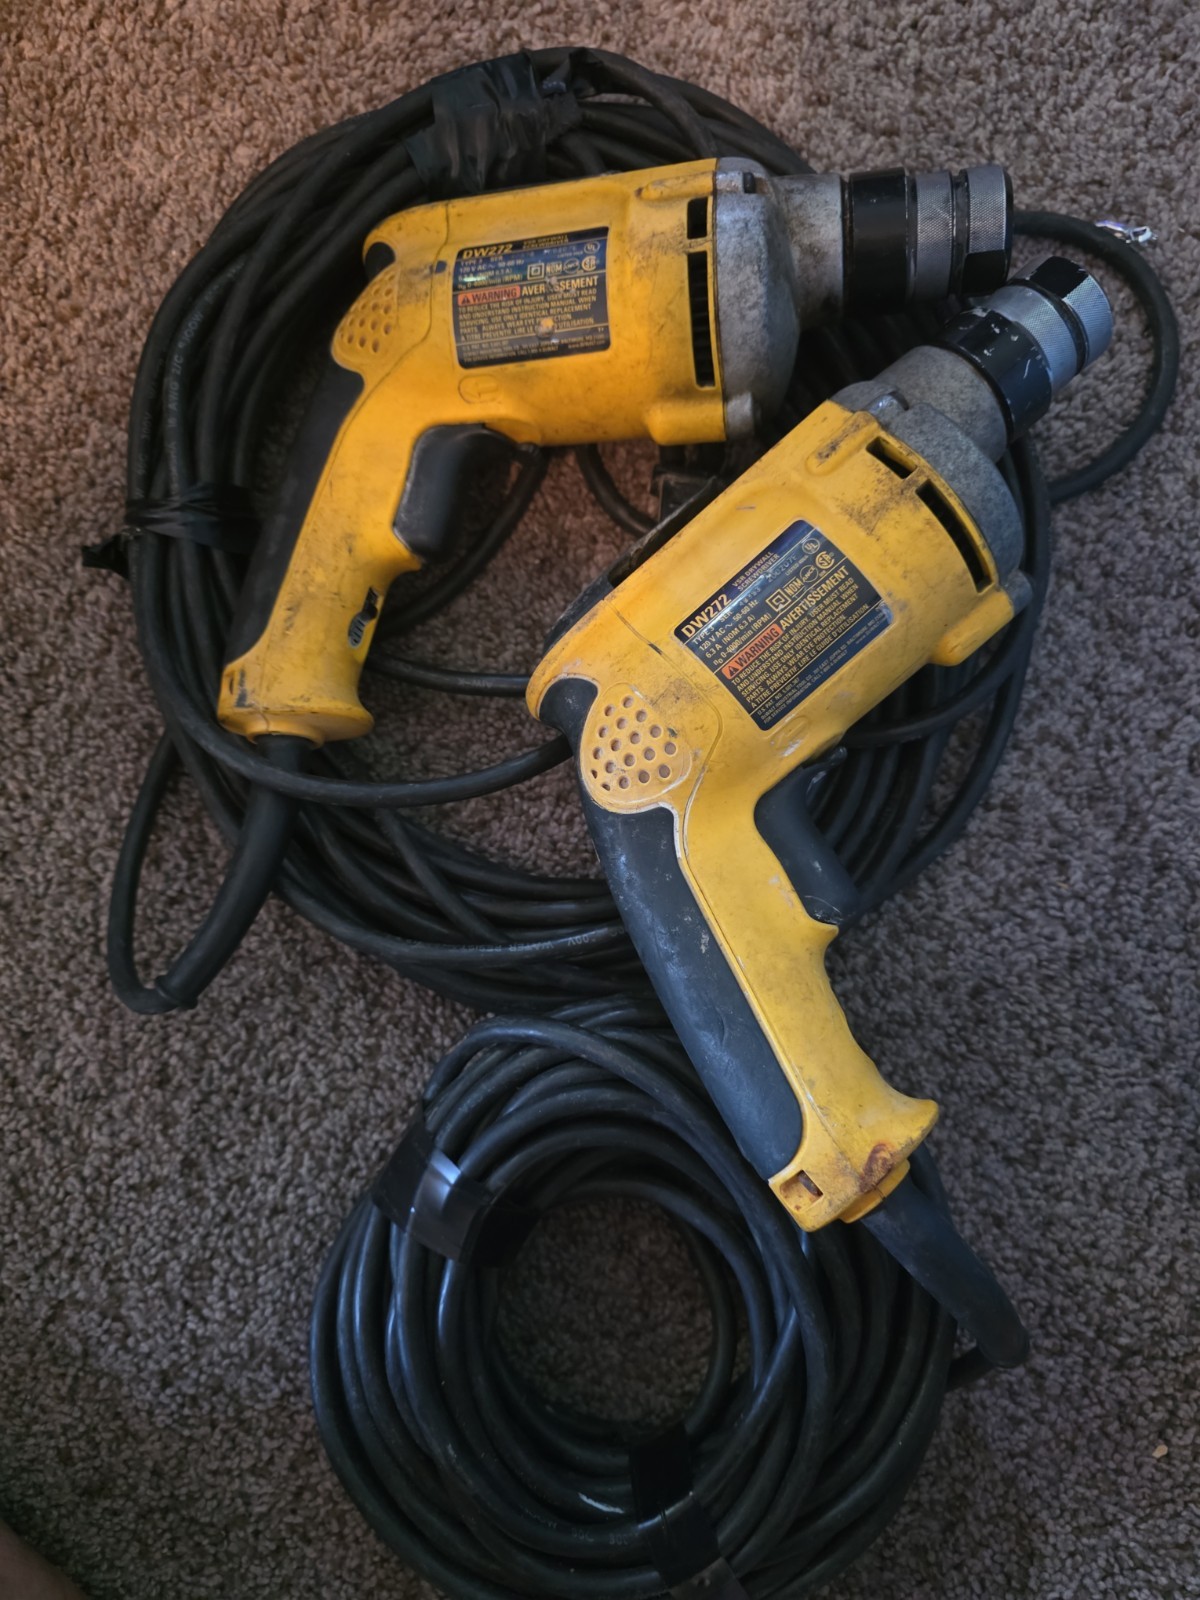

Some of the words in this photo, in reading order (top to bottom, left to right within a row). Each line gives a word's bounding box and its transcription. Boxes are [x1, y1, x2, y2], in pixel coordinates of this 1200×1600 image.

[463, 243, 513, 259] DW272
[472, 288, 517, 303] WARNING
[522, 276, 598, 297] AVERSSEMENT
[473, 307, 510, 319] UNDERSTAND
[511, 302, 549, 313] INSTRUCTION
[578, 295, 596, 304] WHEN
[581, 288, 597, 296] READ
[519, 309, 548, 319] IDENTICAL
[550, 303, 591, 315] REPLACEMENT
[731, 574, 746, 588] VSR
[744, 550, 774, 577] DRYWALL
[737, 553, 780, 592] SCREWDRIVER
[783, 577, 804, 597] NOM
[681, 592, 732, 639] DW272
[692, 628, 711, 646] TYPE
[708, 624, 715, 632] 3
[699, 640, 712, 652] 120
[709, 635, 717, 643] V
[714, 626, 726, 638] AC
[732, 605, 751, 623] 50-60
[748, 598, 759, 609] Hz
[731, 677, 741, 686] TO
[739, 659, 761, 680] REDUCE
[759, 650, 771, 662] THE
[769, 639, 784, 653] RISK
[781, 633, 791, 642] OF
[809, 603, 825, 618] USER
[823, 589, 840, 606] MUST
[838, 577, 855, 592] READ
[734, 627, 780, 669] WARNING
[777, 565, 850, 631] AVERTISSEMENT
[751, 611, 772, 632] (RPM)
[769, 660, 783, 673] USE
[780, 648, 796, 663] ONLY
[794, 625, 823, 651] IDENTICAL
[820, 593, 859, 628] REPLACEMENT
[704, 647, 717, 659] 6.3
[714, 642, 723, 651] A
[721, 627, 741, 645] (NOM
[737, 619, 749, 631] 6.3
[746, 613, 756, 623] A)
[736, 679, 750, 692] AND
[748, 649, 784, 682] UNDERSTAND
[782, 618, 819, 651] INSTRUCTION
[840, 583, 859, 601] WHEN
[755, 689, 772, 704] TITRE
[797, 655, 811, 668] LIRE
[809, 649, 818, 657] LE
[815, 635, 833, 652] GUIDE
[765, 664, 789, 686] ALWAYS
[787, 650, 805, 667] WEAR
[803, 641, 815, 653] EYE
